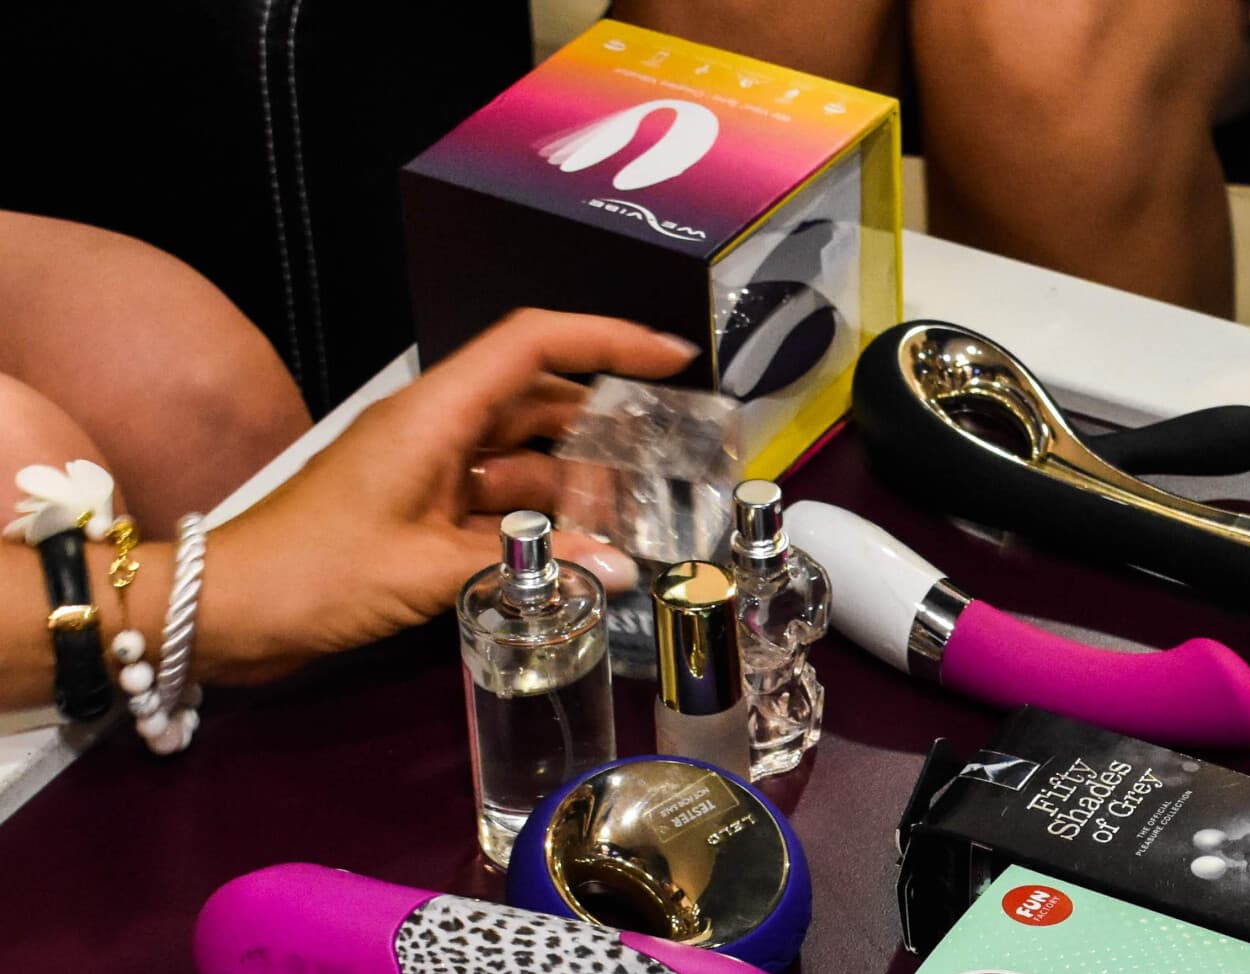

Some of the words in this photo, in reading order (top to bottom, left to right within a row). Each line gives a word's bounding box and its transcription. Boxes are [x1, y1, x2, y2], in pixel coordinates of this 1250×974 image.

[671, 798, 716, 828] TESTER
[1026, 757, 1095, 818] Fifty
[1047, 756, 1133, 841] Shades
[1092, 816, 1120, 845] of
[1107, 768, 1163, 821] Grey
[1136, 826, 1151, 839] THE
[1147, 798, 1172, 826] OFFICIAL
[1136, 825, 1164, 857] PLEASURE
[1161, 789, 1193, 826] COLLECTION
[1015, 889, 1051, 919] FUN
[1034, 895, 1060, 922] FACTORY
